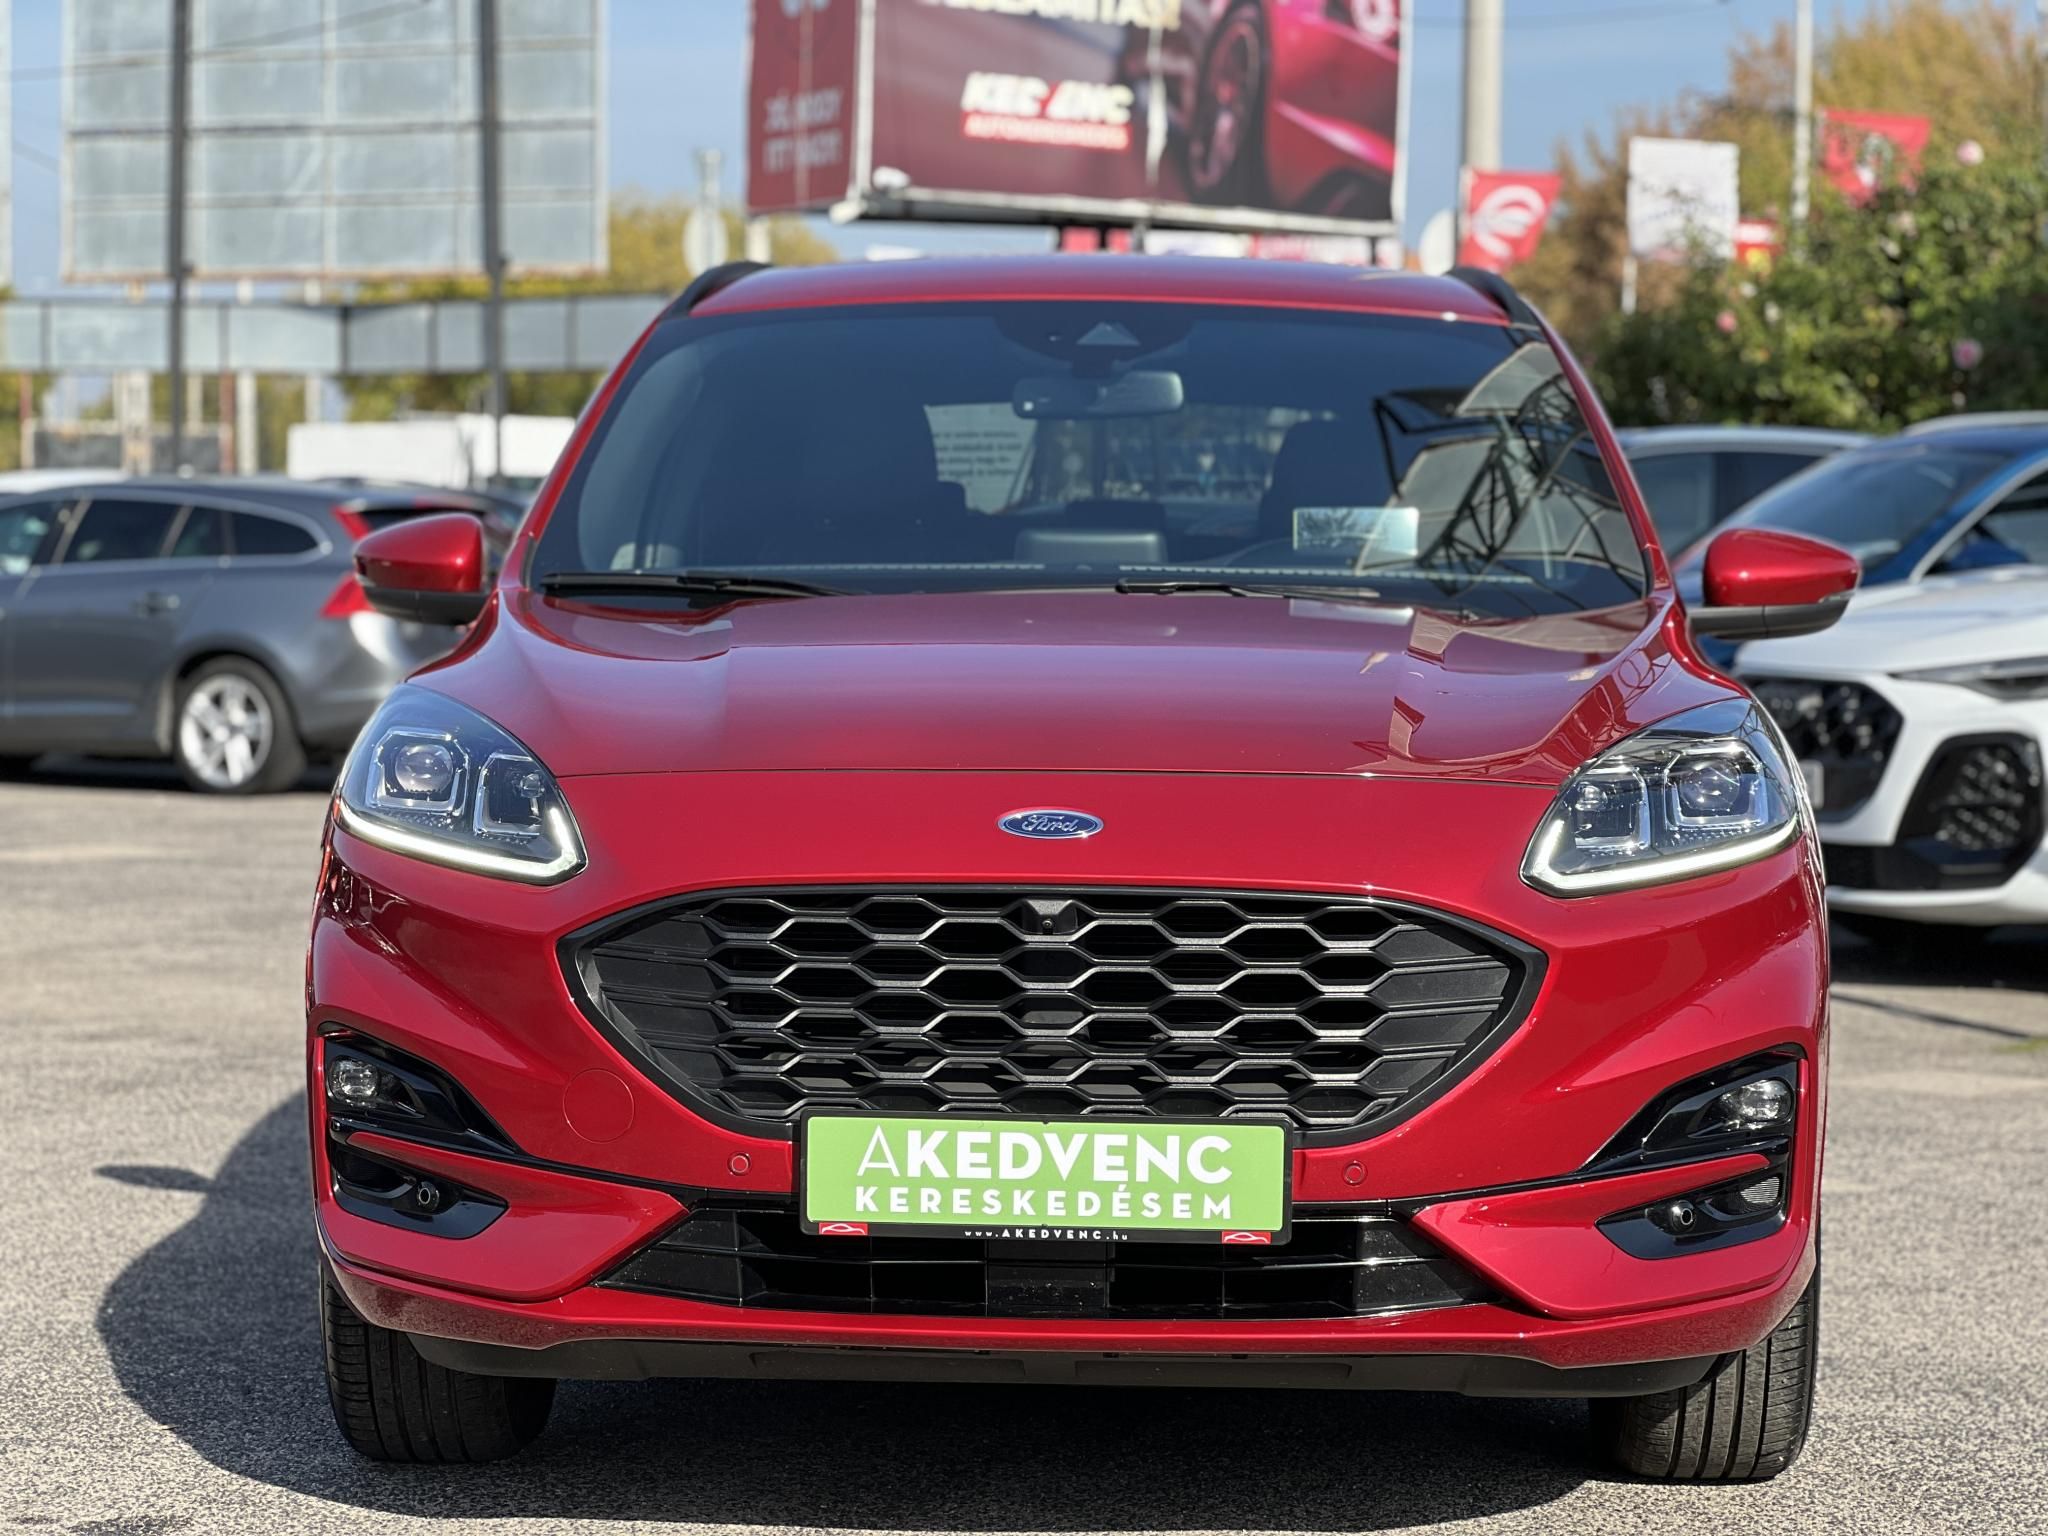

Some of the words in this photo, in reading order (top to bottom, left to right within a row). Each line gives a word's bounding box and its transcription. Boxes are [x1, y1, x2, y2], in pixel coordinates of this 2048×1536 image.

[1021, 814, 1079, 832] Ford
[855, 1184, 1232, 1220] KERESKEDÉSEM
[964, 1228, 1129, 1241] www.AKEDVENC.hu
